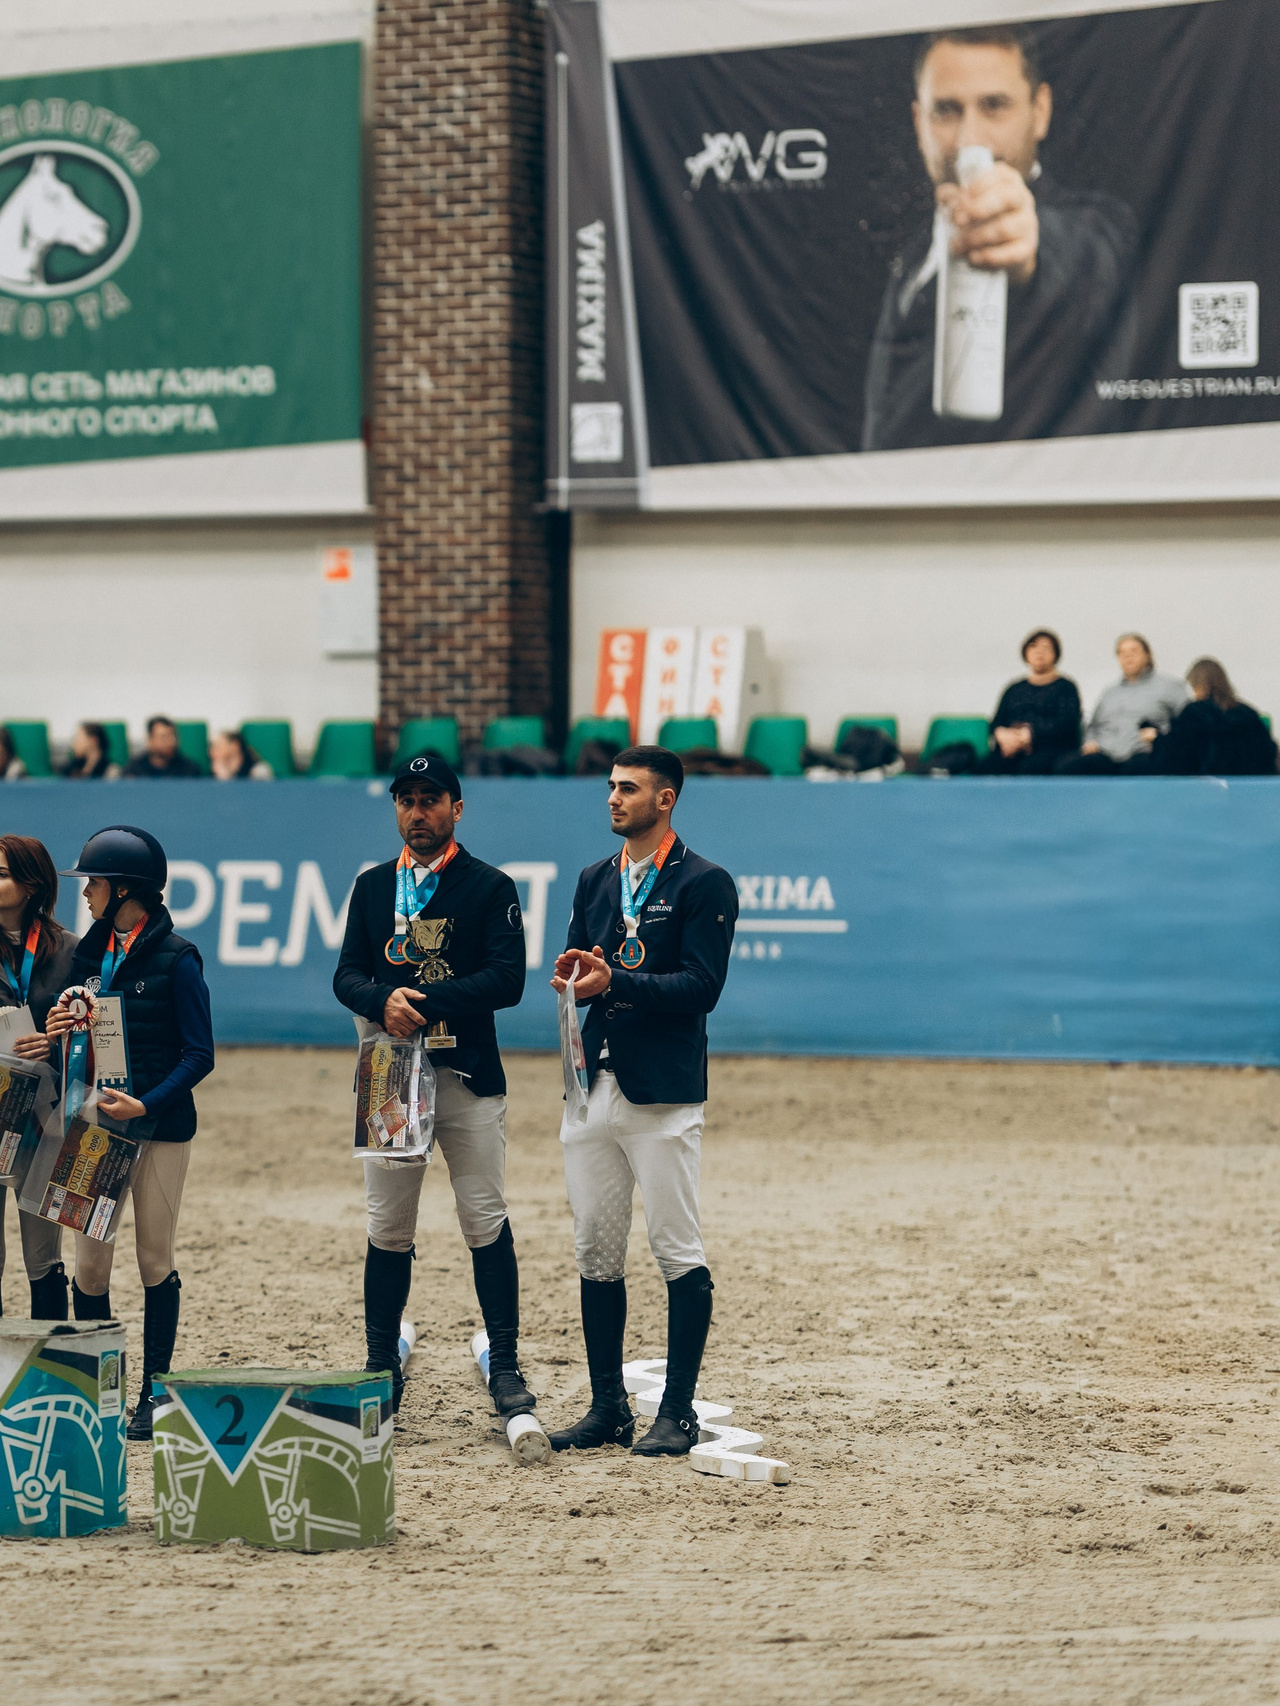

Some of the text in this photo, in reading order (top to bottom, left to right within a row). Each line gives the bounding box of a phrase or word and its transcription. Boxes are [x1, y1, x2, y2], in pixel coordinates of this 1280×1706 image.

[577, 218, 606, 383] MAXIMA
[31, 371, 103, 402] СЕТЬ
[105, 365, 276, 399] МАГАЗИНОВ
[104, 403, 218, 437] СПОРТА
[604, 633, 636, 717] СТА
[657, 636, 680, 715] ФИН
[705, 635, 729, 716] СТА
[736, 875, 836, 911] XIMA
[88, 1134, 100, 1152] 2000
[215, 1394, 247, 1446] 2
